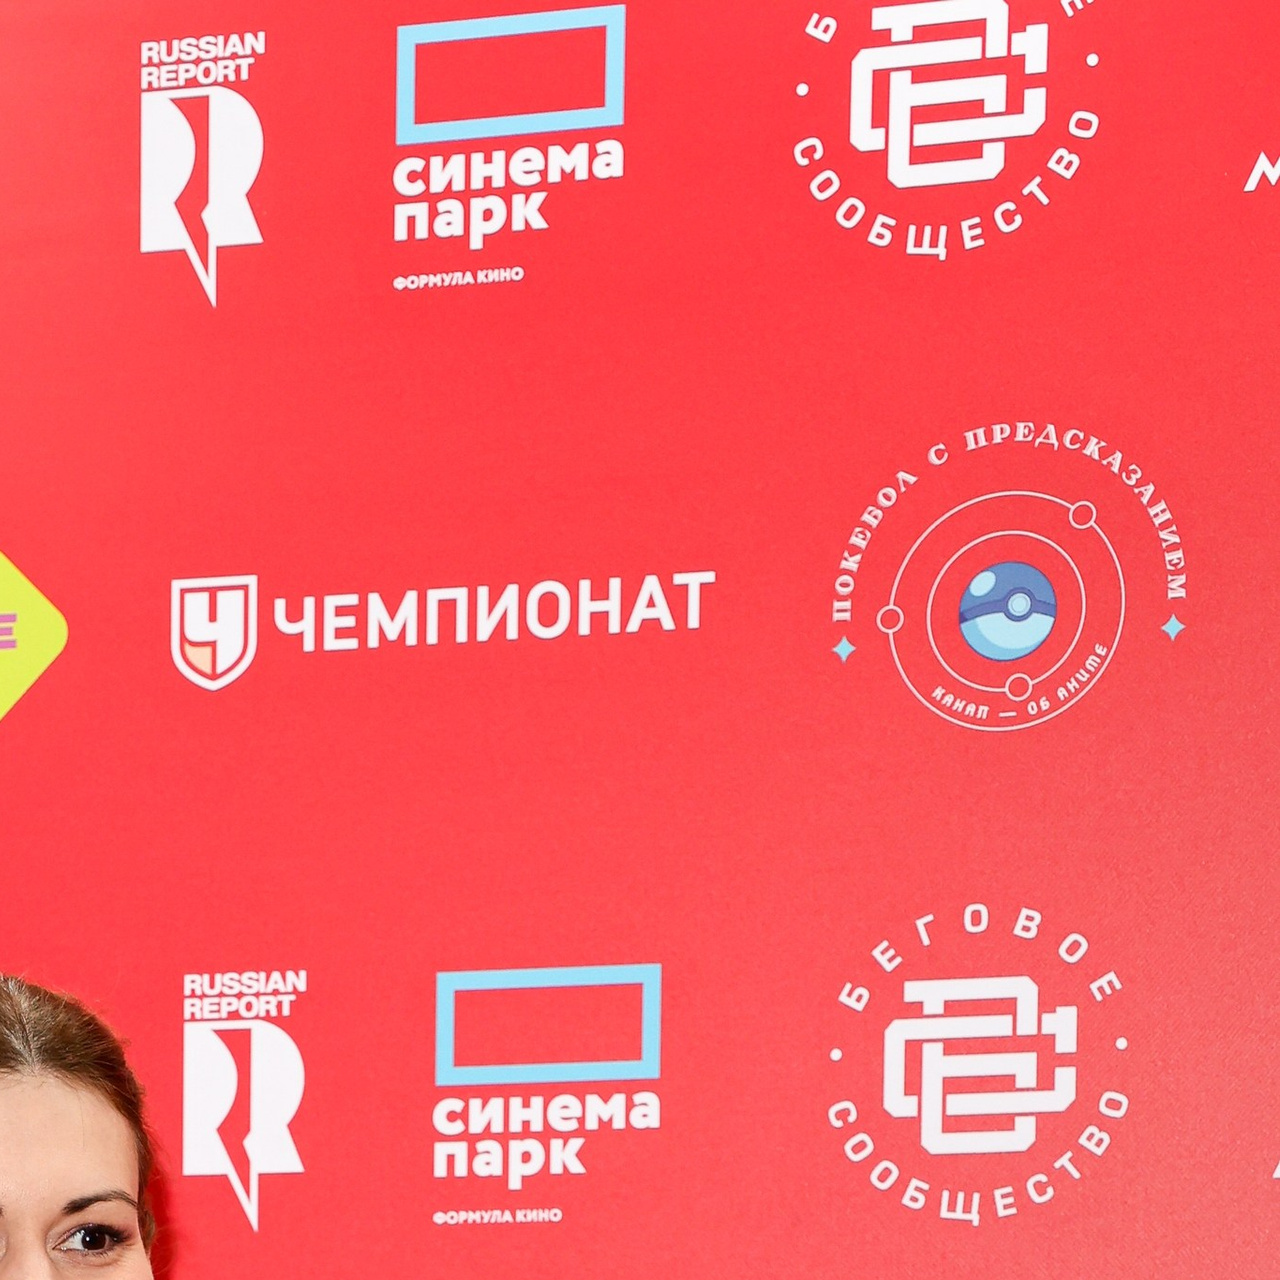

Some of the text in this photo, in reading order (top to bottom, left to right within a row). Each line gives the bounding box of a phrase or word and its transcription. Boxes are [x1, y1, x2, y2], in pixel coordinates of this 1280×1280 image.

[141, 31, 265, 65] RUSSIAN
[141, 57, 255, 90] REPORT
[393, 139, 624, 197] синема
[794, 111, 1099, 261] СООБЩЕСТВО
[394, 191, 549, 251] парк
[393, 266, 524, 290] ФОРМУЛА КИНО
[832, 422, 1187, 622] ПОКЕБОЛ С ПРЕДСКАЗАНИЕМ
[274, 571, 716, 652] ЧЕМПИОНАТ
[183, 970, 307, 997] RUSSIAN
[838, 903, 1122, 1012] БЕГОВОЕ
[183, 994, 296, 1020] REPORT
[432, 1091, 660, 1136] синема
[433, 1137, 586, 1190] парк
[828, 1091, 1129, 1226] СООБЩЕСТВО
[433, 1208, 562, 1225] ФОРМУЛА КИНО
